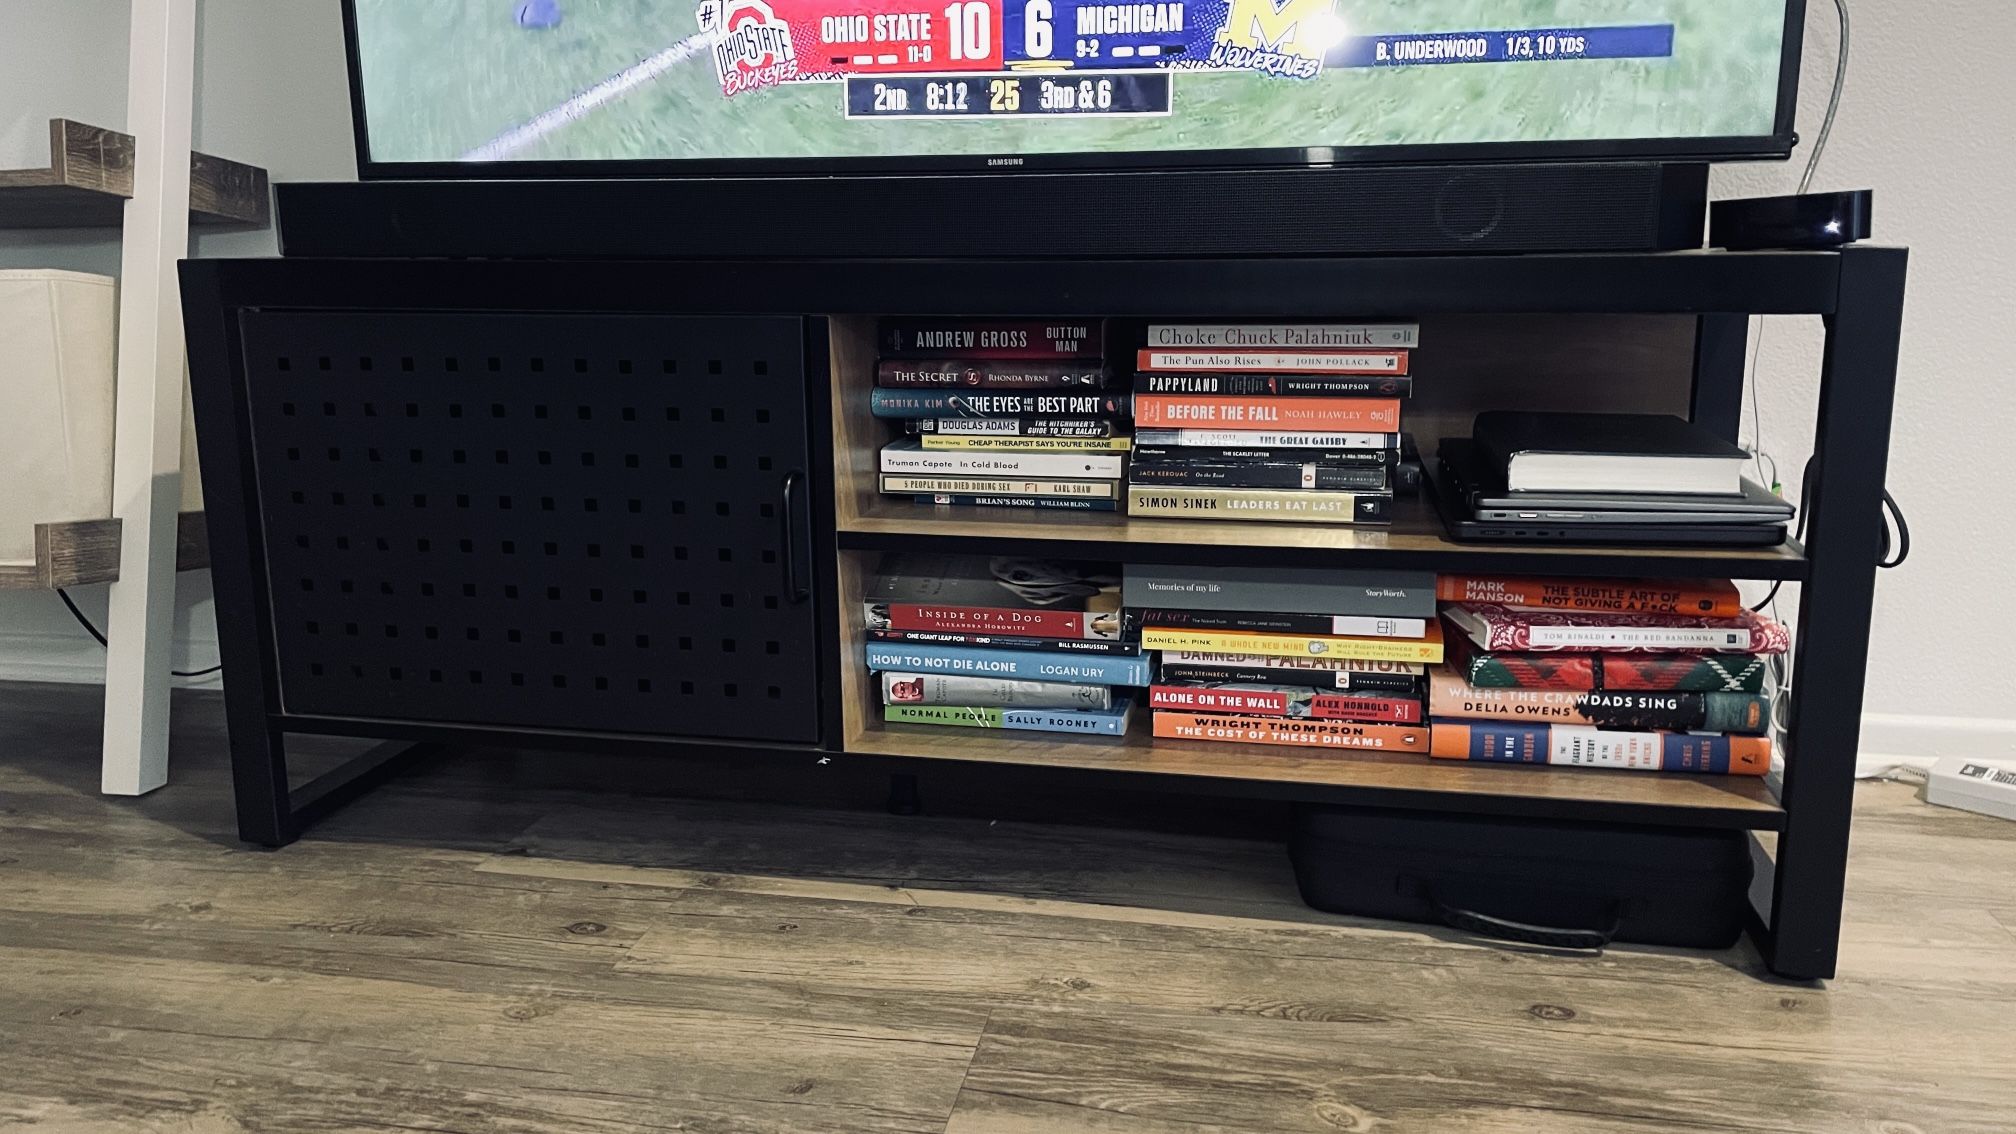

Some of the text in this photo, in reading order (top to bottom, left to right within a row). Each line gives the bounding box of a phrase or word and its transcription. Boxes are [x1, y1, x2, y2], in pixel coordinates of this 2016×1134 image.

[1075, 2, 1184, 35] MICHIGAN
[821, 13, 932, 44] OHIO STATE
[944, 1, 991, 61] 10
[1024, 0, 1053, 59] 6
[1075, 39, 1100, 58] 9-2
[1376, 35, 1585, 61] B. UNDERWOOD 1/3, 10 YDS
[1210, 40, 1320, 78] WOLVERINES
[724, 59, 799, 96] BUCKEYES
[873, 79, 1112, 111] 2ND 8:12 25 3RD & 6
[987, 158, 1024, 166] SAMSUNG
[916, 330, 975, 349] ANDREW
[980, 330, 1028, 349] GROSS
[1046, 326, 1088, 340] BUTTON
[1159, 327, 1374, 346] Choke Chuck Palahniuk
[1055, 340, 1079, 353] MAN
[1161, 355, 1371, 367] The Pun Also Rises JOHN POLLACK
[893, 371, 1050, 384] THE SECRET RHONDA BYRNE
[1149, 377, 1219, 392] PAPPYLAND
[1287, 382, 1323, 391] WRIGHT
[1323, 382, 1371, 392] THOMPSON
[880, 398, 944, 410] MONIKA KIM
[967, 396, 991, 413] THE
[993, 396, 1021, 413] EYES
[1023, 397, 1035, 405] ARE
[1038, 396, 1067, 413] BEST
[1069, 396, 1101, 414] PART
[1167, 404, 1217, 420] BEFORE
[1220, 404, 1245, 420] THE
[1248, 405, 1279, 421] FALL
[1284, 410, 1316, 420] NOAH
[1317, 410, 1363, 421] HAWLEY
[941, 420, 983, 431] DOUGLAS
[985, 420, 1016, 431] ADAMS
[1027, 427, 1048, 435] GUIDE
[1074, 428, 1103, 436] GALAXY
[968, 439, 993, 447] CHEAP
[994, 439, 1034, 448] THERAPIST
[1035, 439, 1055, 448] SAYS
[1056, 440, 1083, 449] YOU'RE
[1083, 441, 1112, 449] INSANE
[1259, 435, 1277, 445] THE
[1279, 436, 1310, 446] GREAT
[1311, 436, 1348, 447] GATSBY
[888, 459, 1019, 471] Truman Capote In Cold Blood
[1138, 470, 1190, 478] JACK KEROUAC
[910, 480, 1092, 494] PEOPLE WHO DIED DURING SEX KARL SHAW
[975, 497, 1036, 507] BRIAN'S SONG
[1139, 496, 1342, 512] SIMON SINEK LEADERS EAT LAST
[1147, 583, 1222, 595] Memories of my life
[1466, 579, 1506, 594] MARK
[1543, 583, 1682, 603] THE SUBTLE ART OF
[1466, 589, 1526, 605] MANSON
[1542, 594, 1637, 612] NOT GIVING A
[918, 607, 1043, 624] INSIDE OF A DOG
[1146, 637, 1178, 645] DANIEL
[1191, 639, 1213, 647] PINK
[1230, 639, 1258, 649] WHOLE
[1262, 641, 1281, 651] NEW
[1282, 642, 1305, 652] MIND
[1543, 632, 1716, 644] TOM RINALDI THE RED BANDANNA
[1058, 641, 1110, 653] BILL RASMUSSEN
[872, 653, 1105, 678] HOW TO NOT DIE ALONE LOGAN URY
[1174, 670, 1230, 680] JOHN STEINBECK
[1153, 692, 1282, 711] ALONE ON THE WALL
[1315, 699, 1341, 709] ALEX
[1343, 700, 1390, 713] HONNOLD
[1449, 687, 1678, 712] WHERE THE CRAWDADS SING
[1463, 702, 1571, 718] DELIA OWENS
[901, 709, 1098, 730] NORMAL PEOPLE SALLY ROONEY
[1194, 718, 1365, 736] WRIGHT THOMPSON
[1175, 726, 1385, 748] THE COST OF THESE DREAMS
